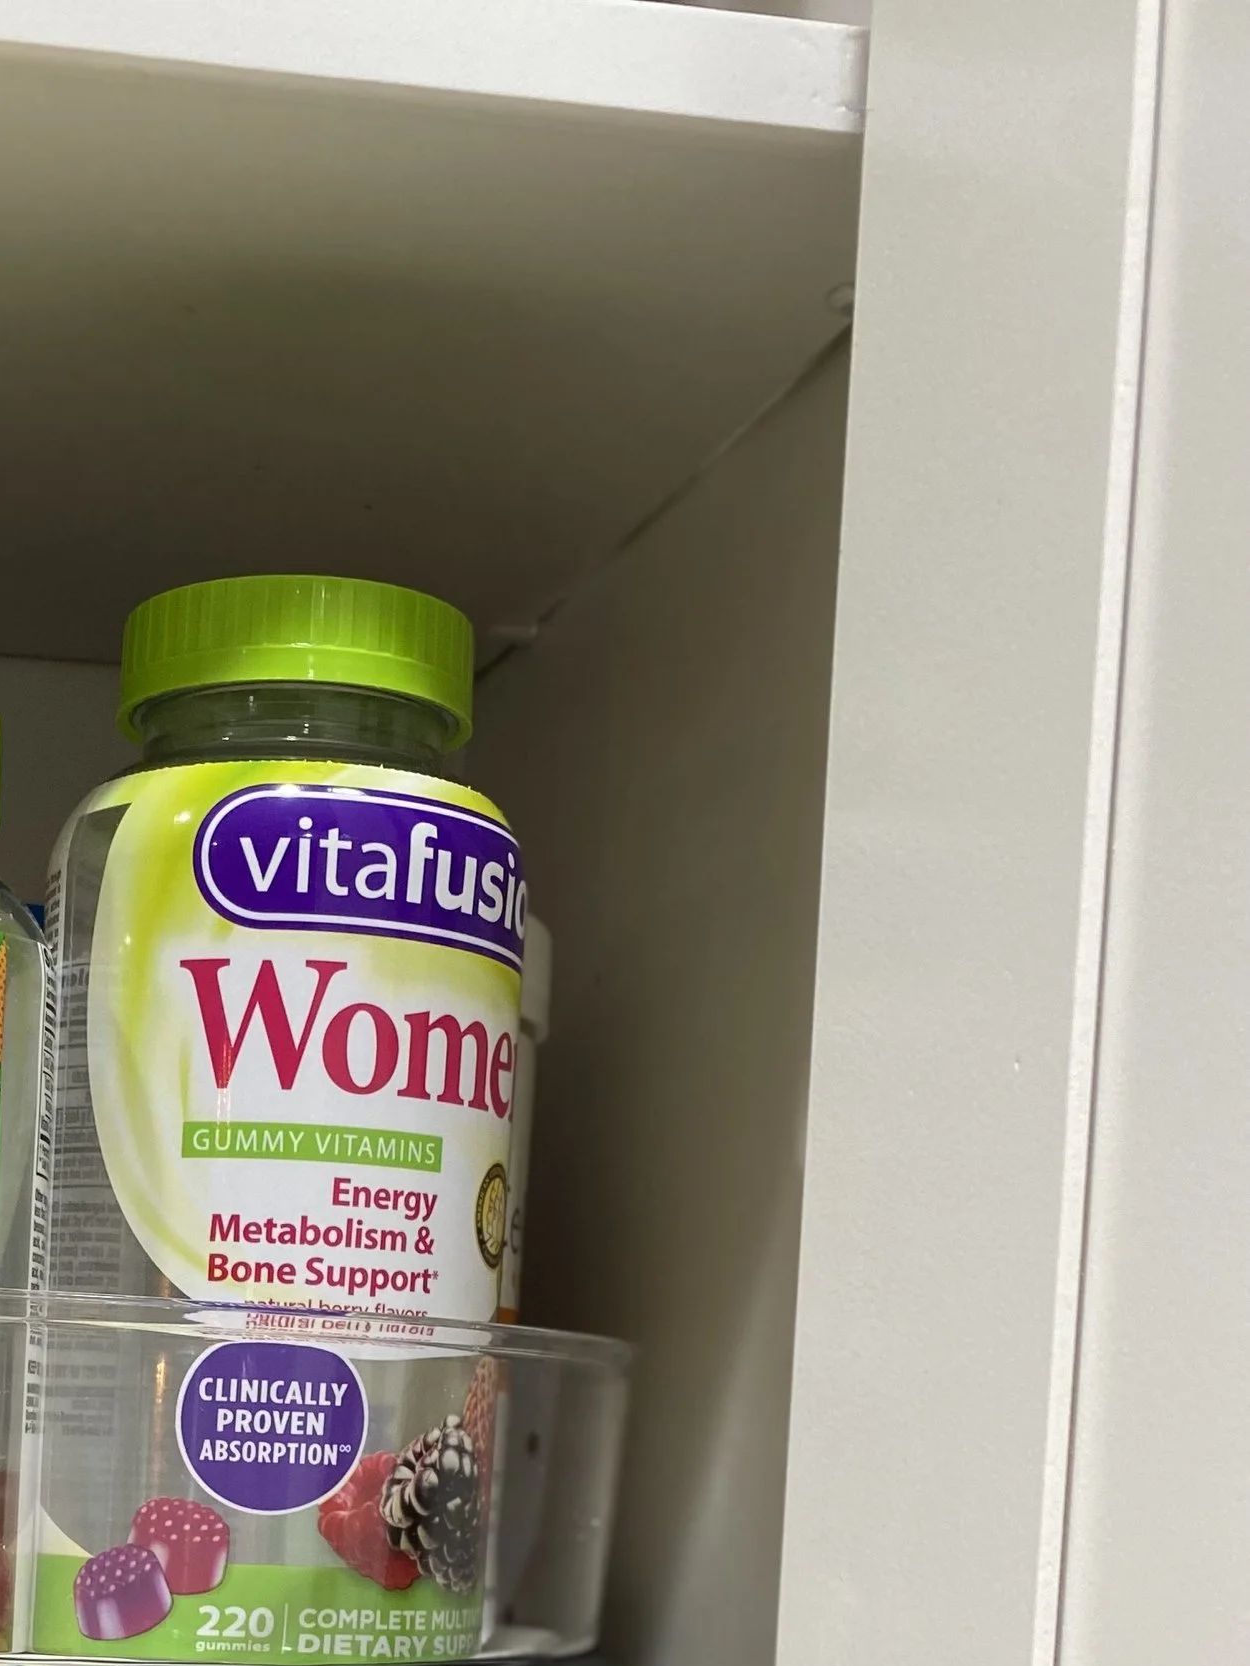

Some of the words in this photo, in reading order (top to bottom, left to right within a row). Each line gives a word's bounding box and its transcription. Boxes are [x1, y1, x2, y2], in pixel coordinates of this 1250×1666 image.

[180, 959, 519, 1121] Wome
[194, 1129, 303, 1153] GUMMY
[317, 1133, 436, 1164] VITAMINS
[332, 1179, 437, 1218] Energy
[209, 1214, 406, 1252] Metabolism
[415, 1227, 434, 1254] &
[207, 1254, 296, 1285] Bone
[199, 1377, 347, 1406] CLINICALLY
[217, 1409, 324, 1436] PROVEN
[196, 1606, 274, 1638] 220
[300, 1610, 426, 1630] COMPLETE
[196, 1641, 270, 1652] gummies
[298, 1634, 426, 1658] DIETARY
